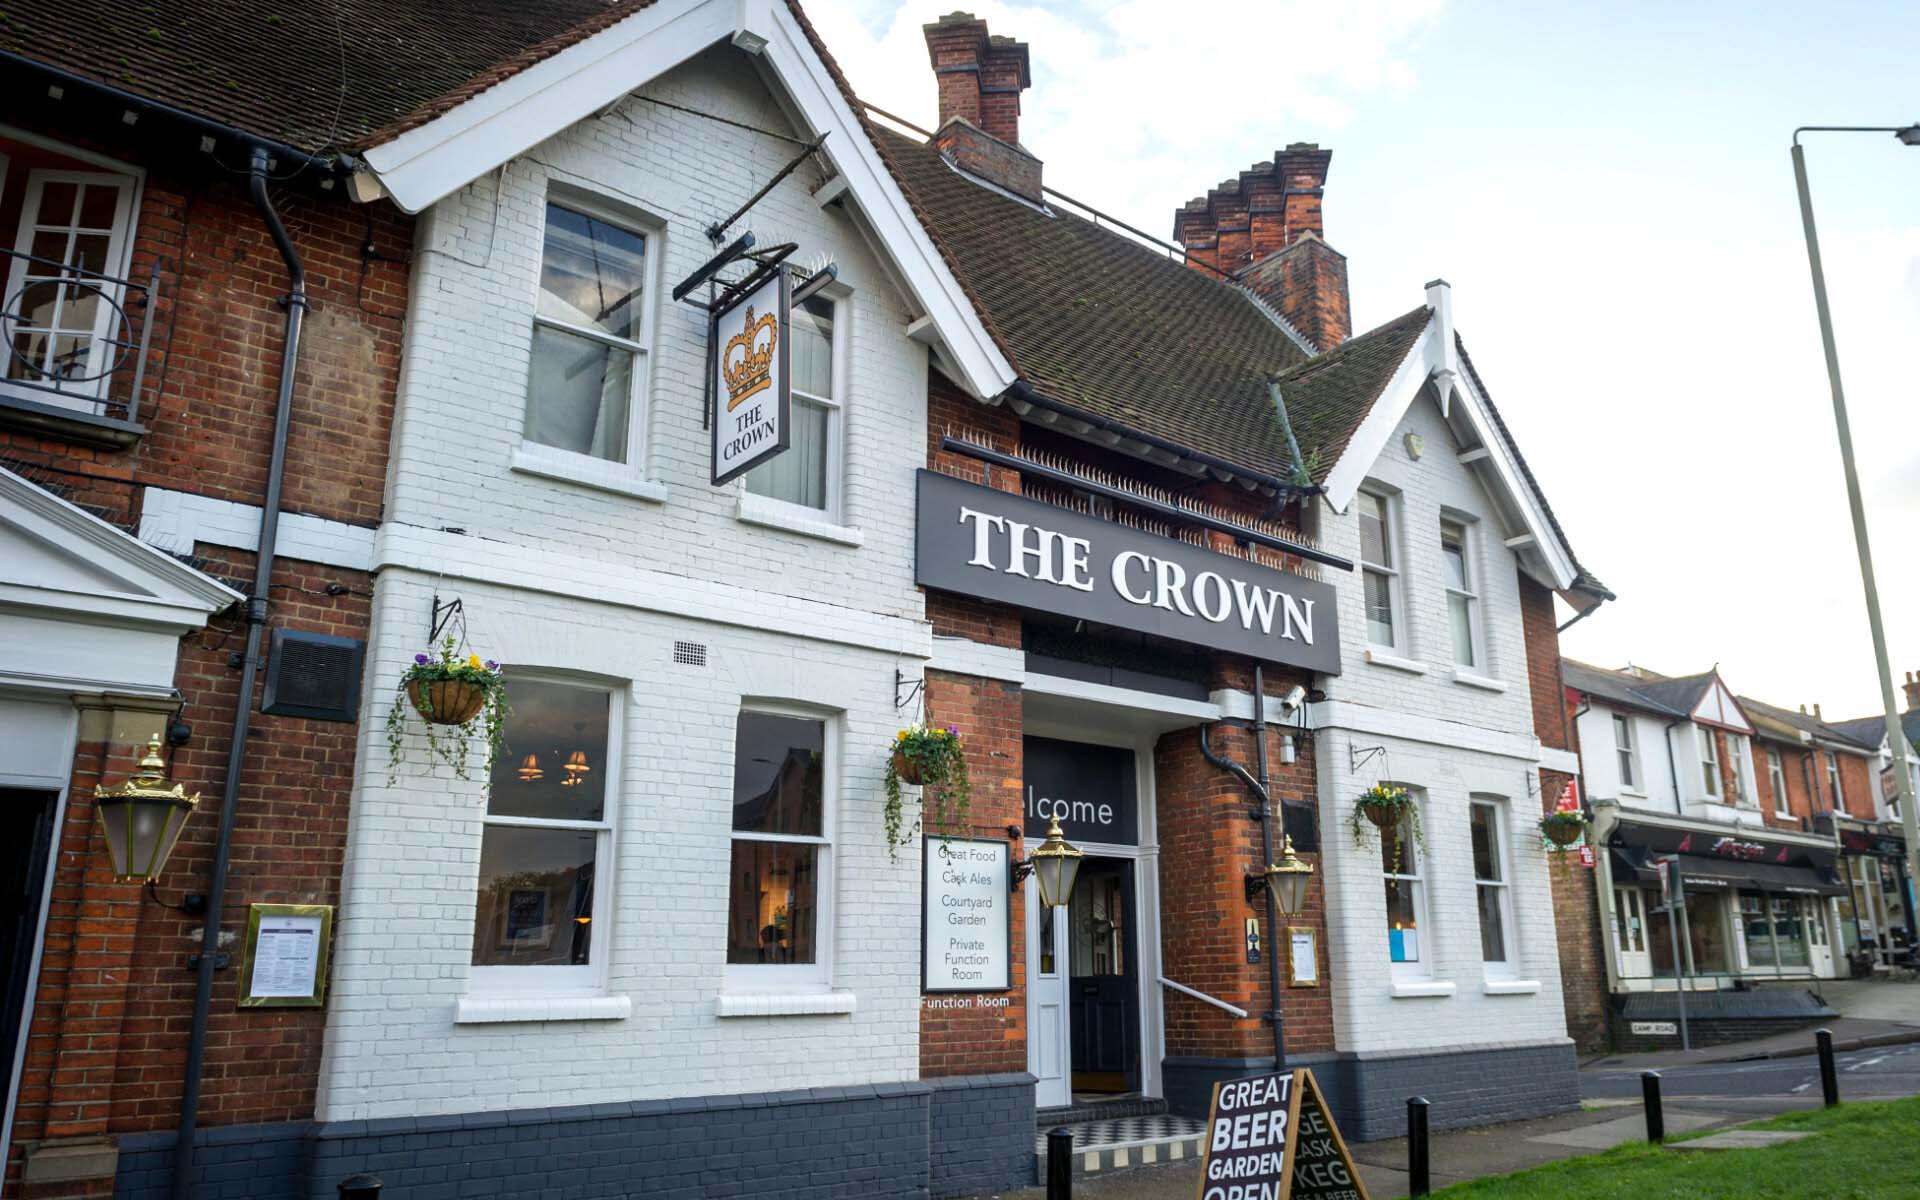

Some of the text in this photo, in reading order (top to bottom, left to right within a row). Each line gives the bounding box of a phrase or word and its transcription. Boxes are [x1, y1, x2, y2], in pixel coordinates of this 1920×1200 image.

[736, 403, 762, 433] THE
[724, 417, 775, 461] CROWN
[958, 506, 1316, 646] THE CROWN
[1023, 785, 1113, 825] lcome
[970, 849, 996, 862] Food
[942, 871, 992, 886] Cask Ales
[942, 895, 992, 910] Courtyard
[948, 912, 986, 926] Garden
[950, 937, 985, 951] Private
[945, 952, 989, 965] Function
[952, 968, 983, 980] Room
[920, 994, 1010, 1009] Function Room
[1655, 1024, 1674, 1033] ROAD
[1218, 1073, 1293, 1111] GREAT
[1212, 1110, 1287, 1152] BEER
[1297, 1112, 1328, 1136] GE
[1295, 1138, 1338, 1159] ASK
[1208, 1151, 1284, 1181] GARDEN
[1294, 1160, 1352, 1189] KEG
